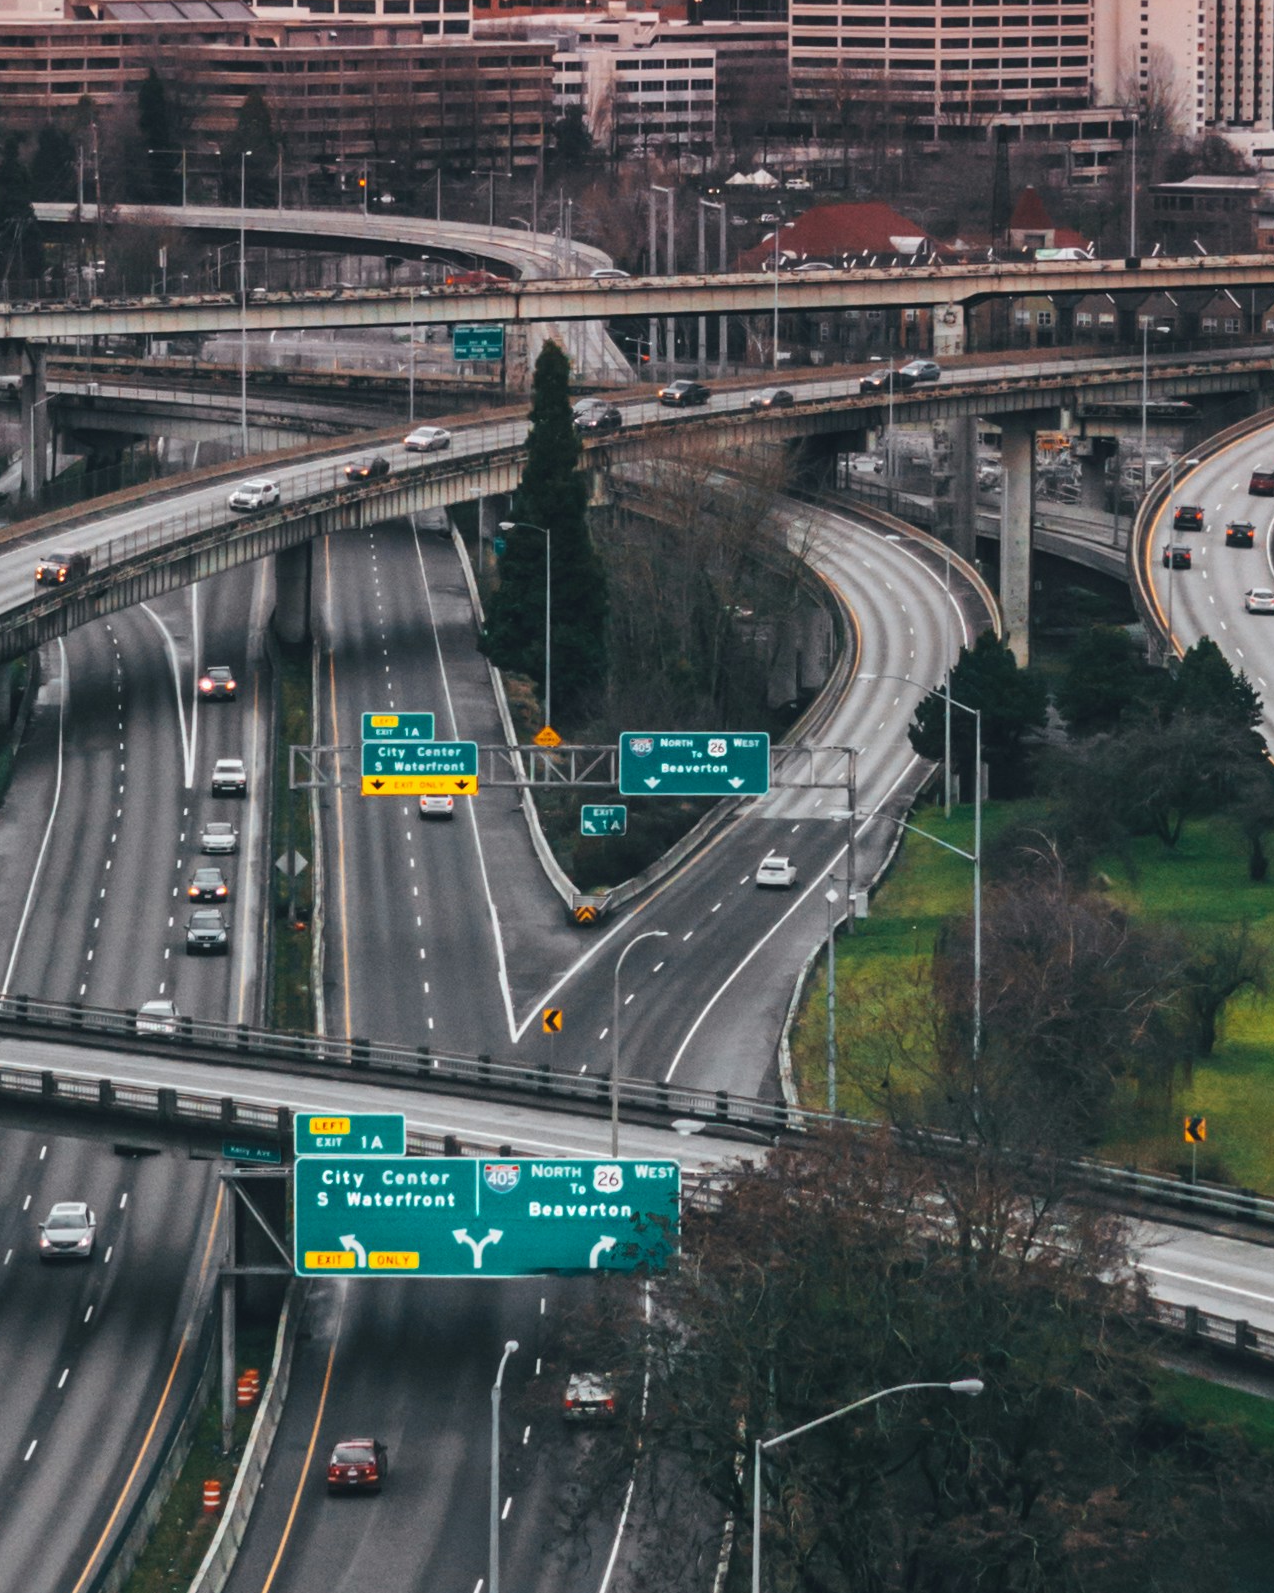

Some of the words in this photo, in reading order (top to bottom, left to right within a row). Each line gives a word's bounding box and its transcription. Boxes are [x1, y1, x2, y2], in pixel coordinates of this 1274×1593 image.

[375, 728, 394, 736] EXIT
[404, 727, 420, 737] 1A
[378, 747, 406, 759] City
[417, 746, 462, 757] Center
[632, 742, 653, 753] 405
[660, 738, 693, 748] NORTH
[709, 742, 725, 754] 26
[733, 738, 760, 748] WEST
[374, 761, 383, 772] S
[394, 761, 465, 772] Waterfront
[661, 763, 728, 773] Beaverton
[394, 781, 413, 789] EXIT
[419, 781, 444, 789] ONLY
[593, 808, 614, 817] EXIT
[314, 1121, 344, 1131] LEFT
[316, 1137, 342, 1148] EXIT
[361, 1135, 384, 1149] 1A
[321, 1169, 364, 1189] City
[382, 1169, 450, 1185] Center
[487, 1171, 518, 1186] 405
[531, 1163, 582, 1178] NORTH
[597, 1170, 620, 1187] 26
[635, 1164, 675, 1179] WEST
[317, 1191, 329, 1207] S
[346, 1191, 455, 1207] Waterfront
[529, 1201, 632, 1217] Beaverton
[317, 1250, 342, 1265] EXIT
[377, 1250, 410, 1265] ONLY
